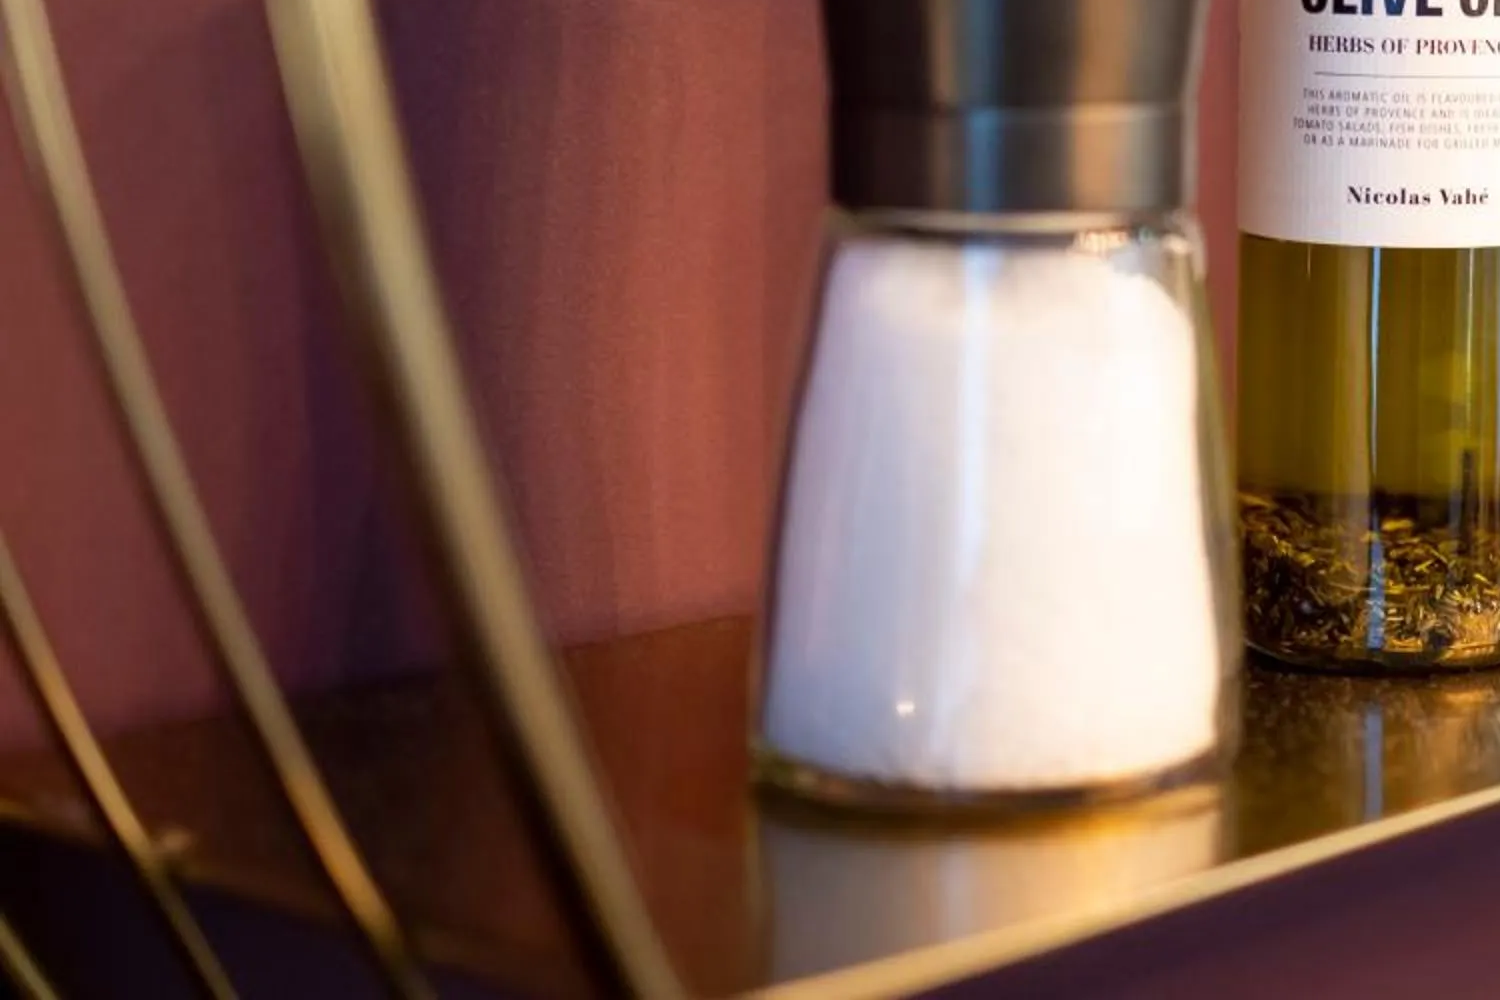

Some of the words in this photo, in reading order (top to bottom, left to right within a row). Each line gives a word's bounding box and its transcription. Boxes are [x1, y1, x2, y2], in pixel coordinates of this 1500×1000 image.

[1308, 34, 1375, 55] HERBS
[1381, 37, 1410, 56] OF
[1304, 88, 1325, 100] THIS
[1329, 90, 1387, 103] AROMATIC
[1393, 92, 1410, 104] OIL
[1308, 105, 1341, 117] HERBS
[1345, 106, 1360, 118] OF
[1365, 107, 1425, 119] PROVENCE
[1293, 117, 1334, 131] TOMATO
[1304, 134, 1317, 145] OR
[1321, 135, 1334, 147] AS
[1337, 136, 1345, 147] A
[1349, 137, 1410, 149] MARINADE
[1417, 138, 1439, 150] FOR
[1347, 185, 1431, 205] Nicolas
[1439, 187, 1489, 205] Vahé
